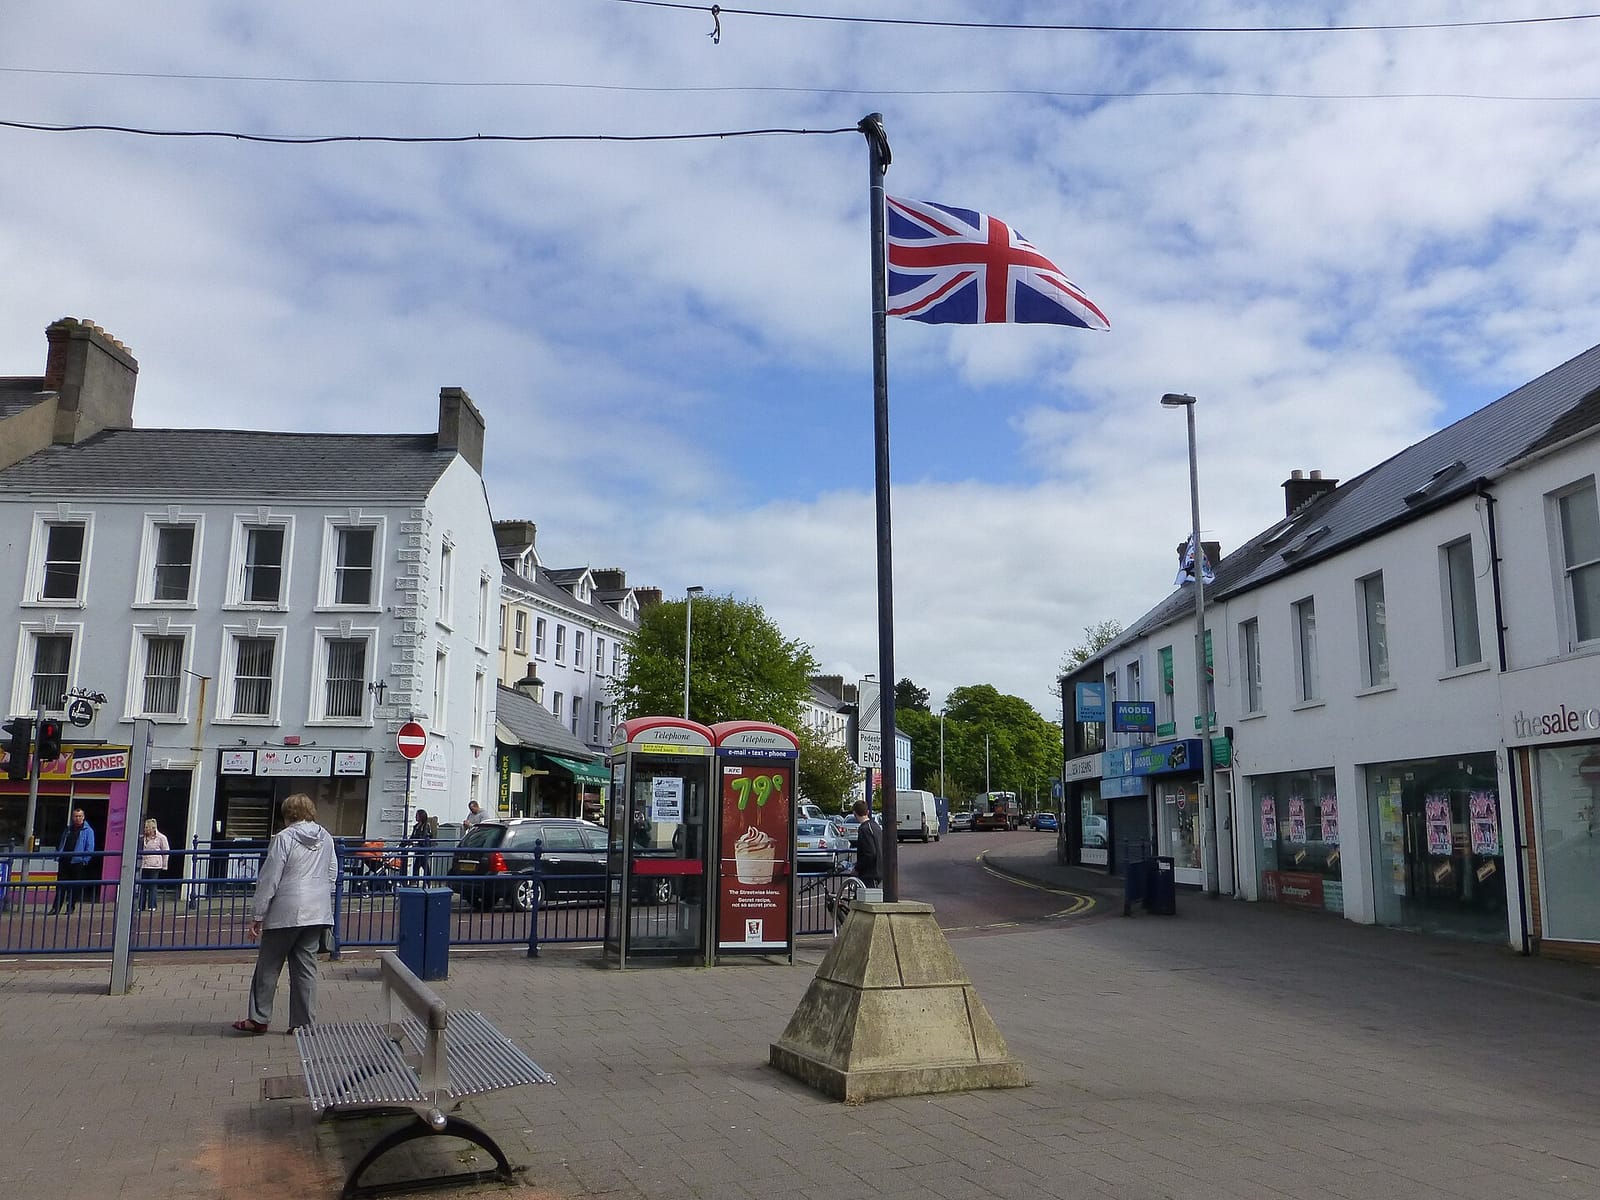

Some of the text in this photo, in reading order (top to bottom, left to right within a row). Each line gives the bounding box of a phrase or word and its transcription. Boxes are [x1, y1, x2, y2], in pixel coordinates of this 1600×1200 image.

[1119, 706, 1152, 714] MODEL
[654, 731, 691, 741] Telephone
[741, 735, 776, 744] Telephone
[283, 753, 328, 765] LOTUS
[863, 752, 882, 763] END
[73, 755, 124, 772] CORNER
